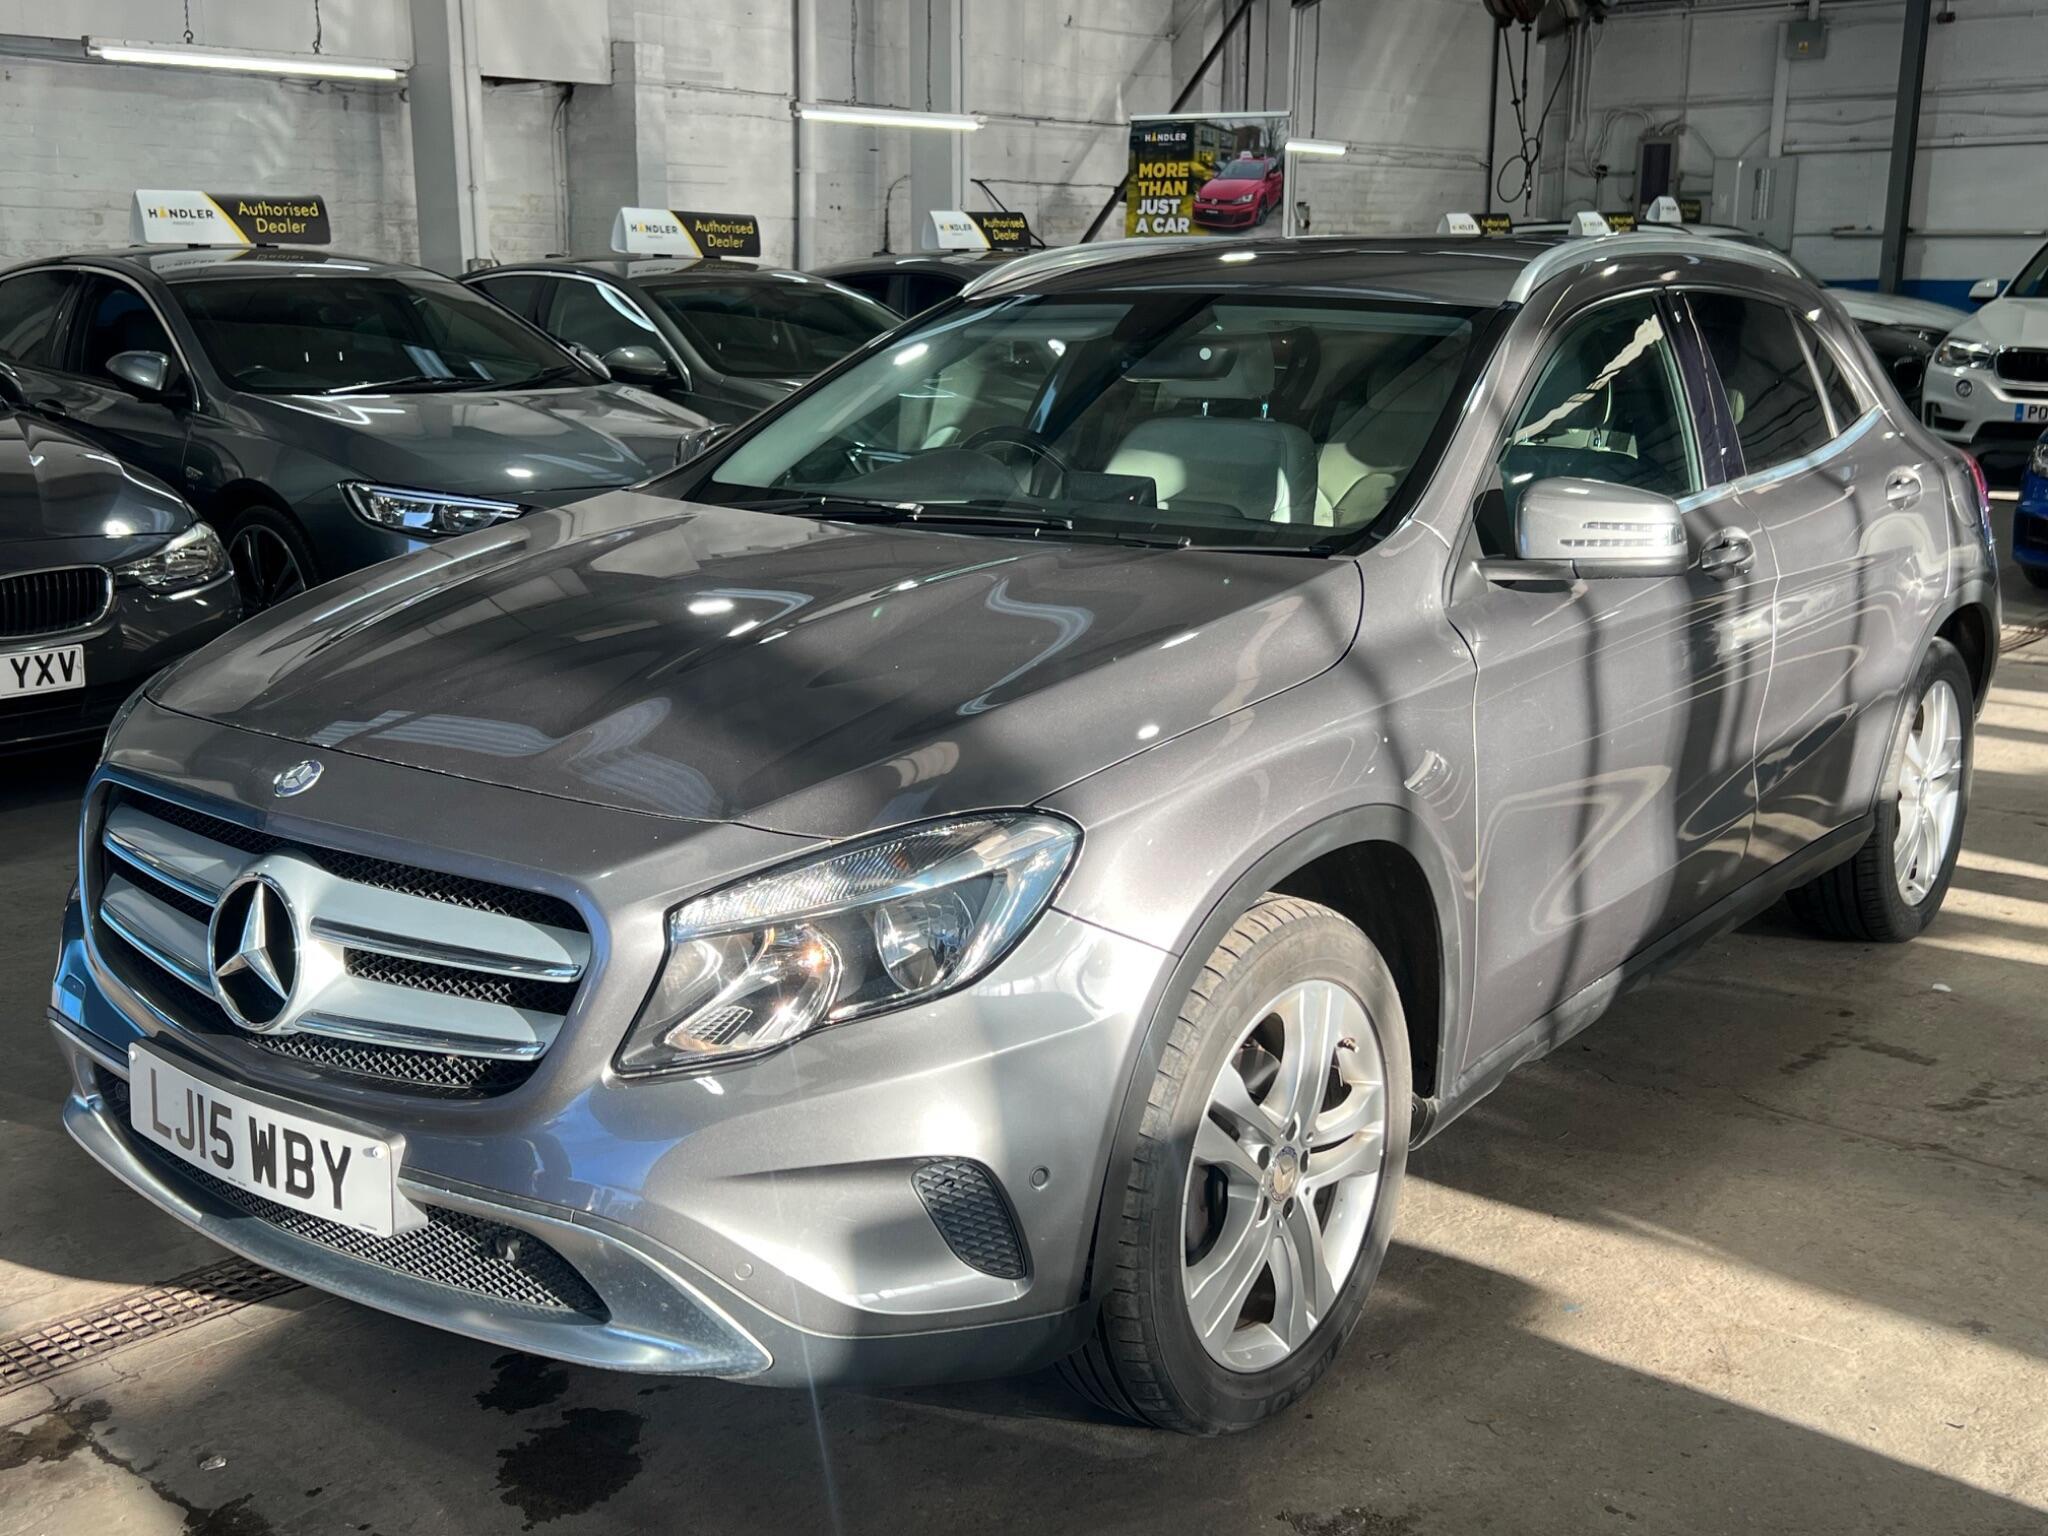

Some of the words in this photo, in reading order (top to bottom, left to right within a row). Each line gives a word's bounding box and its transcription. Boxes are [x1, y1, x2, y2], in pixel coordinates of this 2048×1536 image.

[1138, 162, 1190, 178] MORE
[1138, 181, 1187, 196] THAN
[238, 201, 319, 217] Authorised
[1137, 199, 1181, 215] JUST
[256, 217, 306, 234] Dealer
[695, 220, 754, 234] Authorised
[1136, 219, 1148, 233] A
[1152, 217, 1190, 233] CAR
[707, 234, 744, 248] Dealer
[10, 650, 76, 688] YXV
[150, 1068, 235, 1170] LJ15
[248, 1115, 352, 1210] WBY
